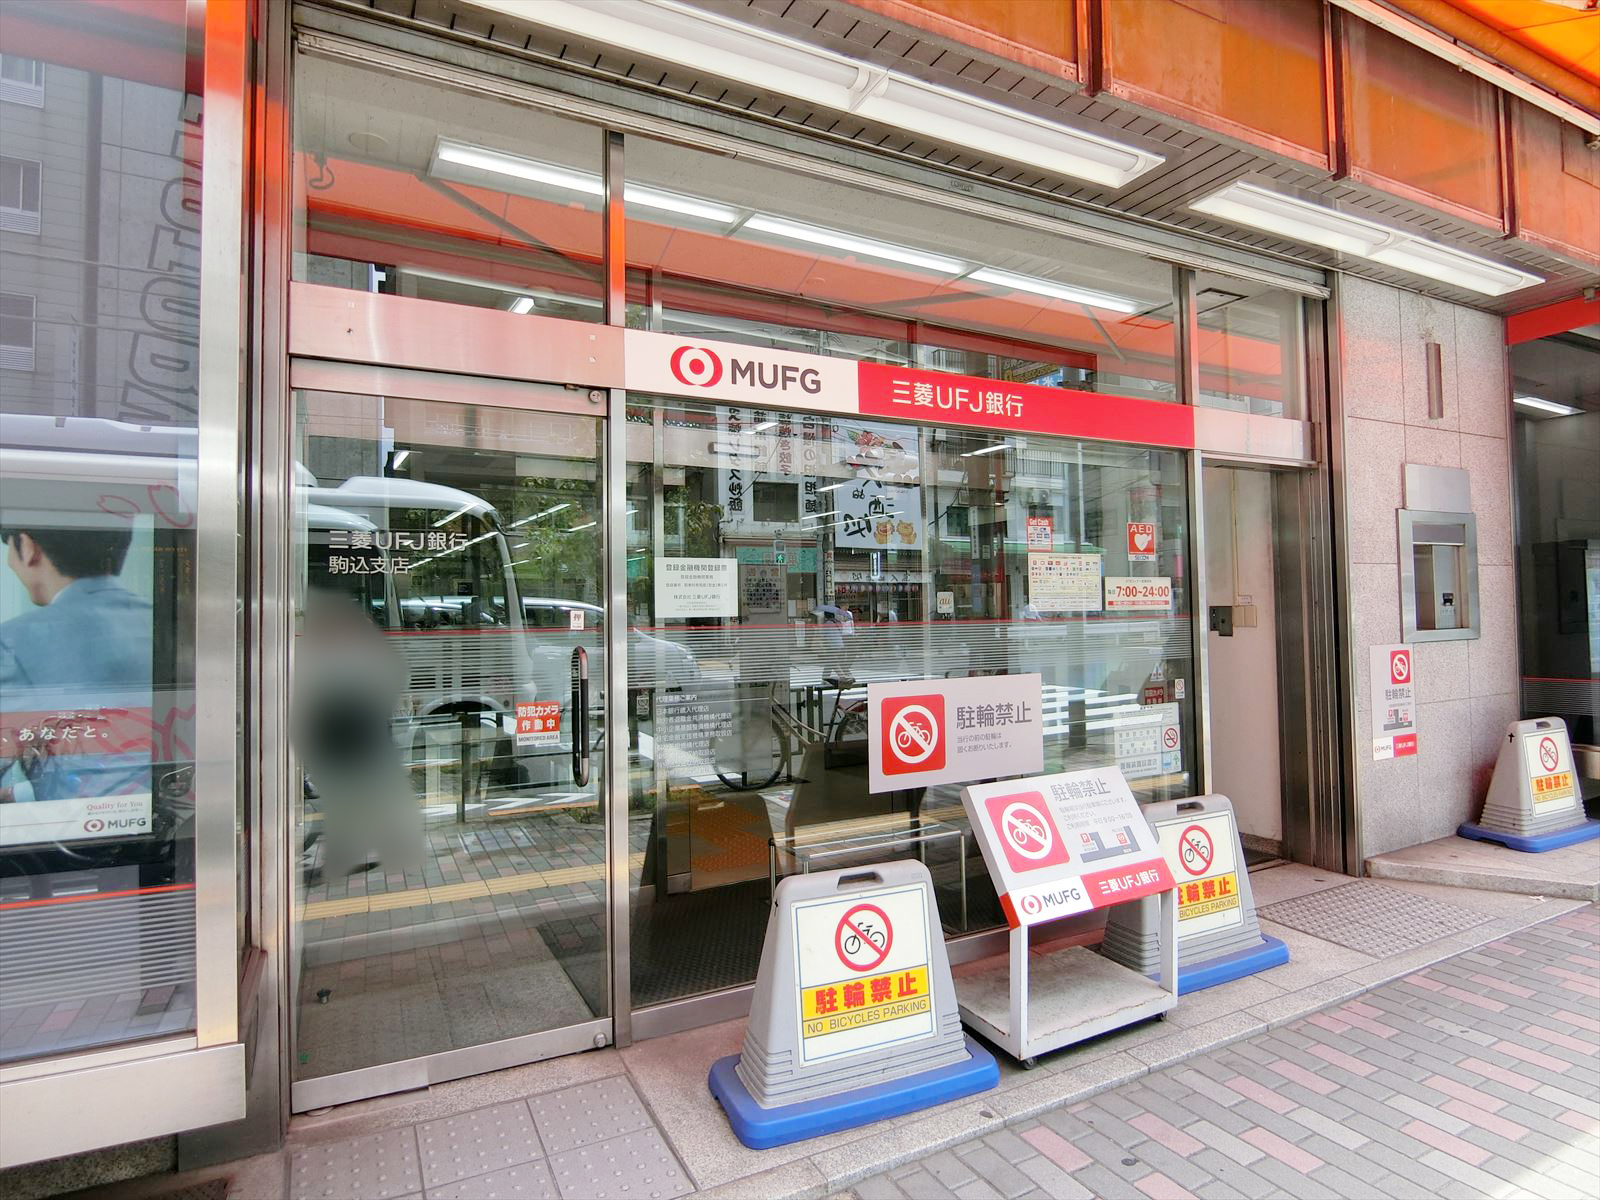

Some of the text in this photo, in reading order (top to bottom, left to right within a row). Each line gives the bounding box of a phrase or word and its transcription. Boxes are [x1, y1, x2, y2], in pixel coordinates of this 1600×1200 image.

[731, 358, 822, 394] MUFG
[892, 380, 1024, 418] 三菱UFJ銀行
[1129, 524, 1152, 533] AED
[328, 530, 468, 551] 三菱UFJ銀行
[328, 556, 410, 575] 駒込支店
[517, 705, 559, 718] 防犯カメラ
[956, 701, 1033, 730] 駐輪禁止
[521, 718, 556, 731] 作動中
[957, 732, 1002, 744] 当行の前の駐輪は
[1050, 778, 1111, 802] 駐輪禁止
[86, 802, 114, 811] Quality
[108, 818, 147, 829] MUFG
[1098, 869, 1161, 895] 三菱UFJ銀行
[1042, 887, 1081, 908] MUFG
[1179, 897, 1238, 919] BICYCLES PARKING
[815, 972, 918, 1015] 駐輪禁止
[807, 999, 927, 1034] NO BICYCLES PARKING
